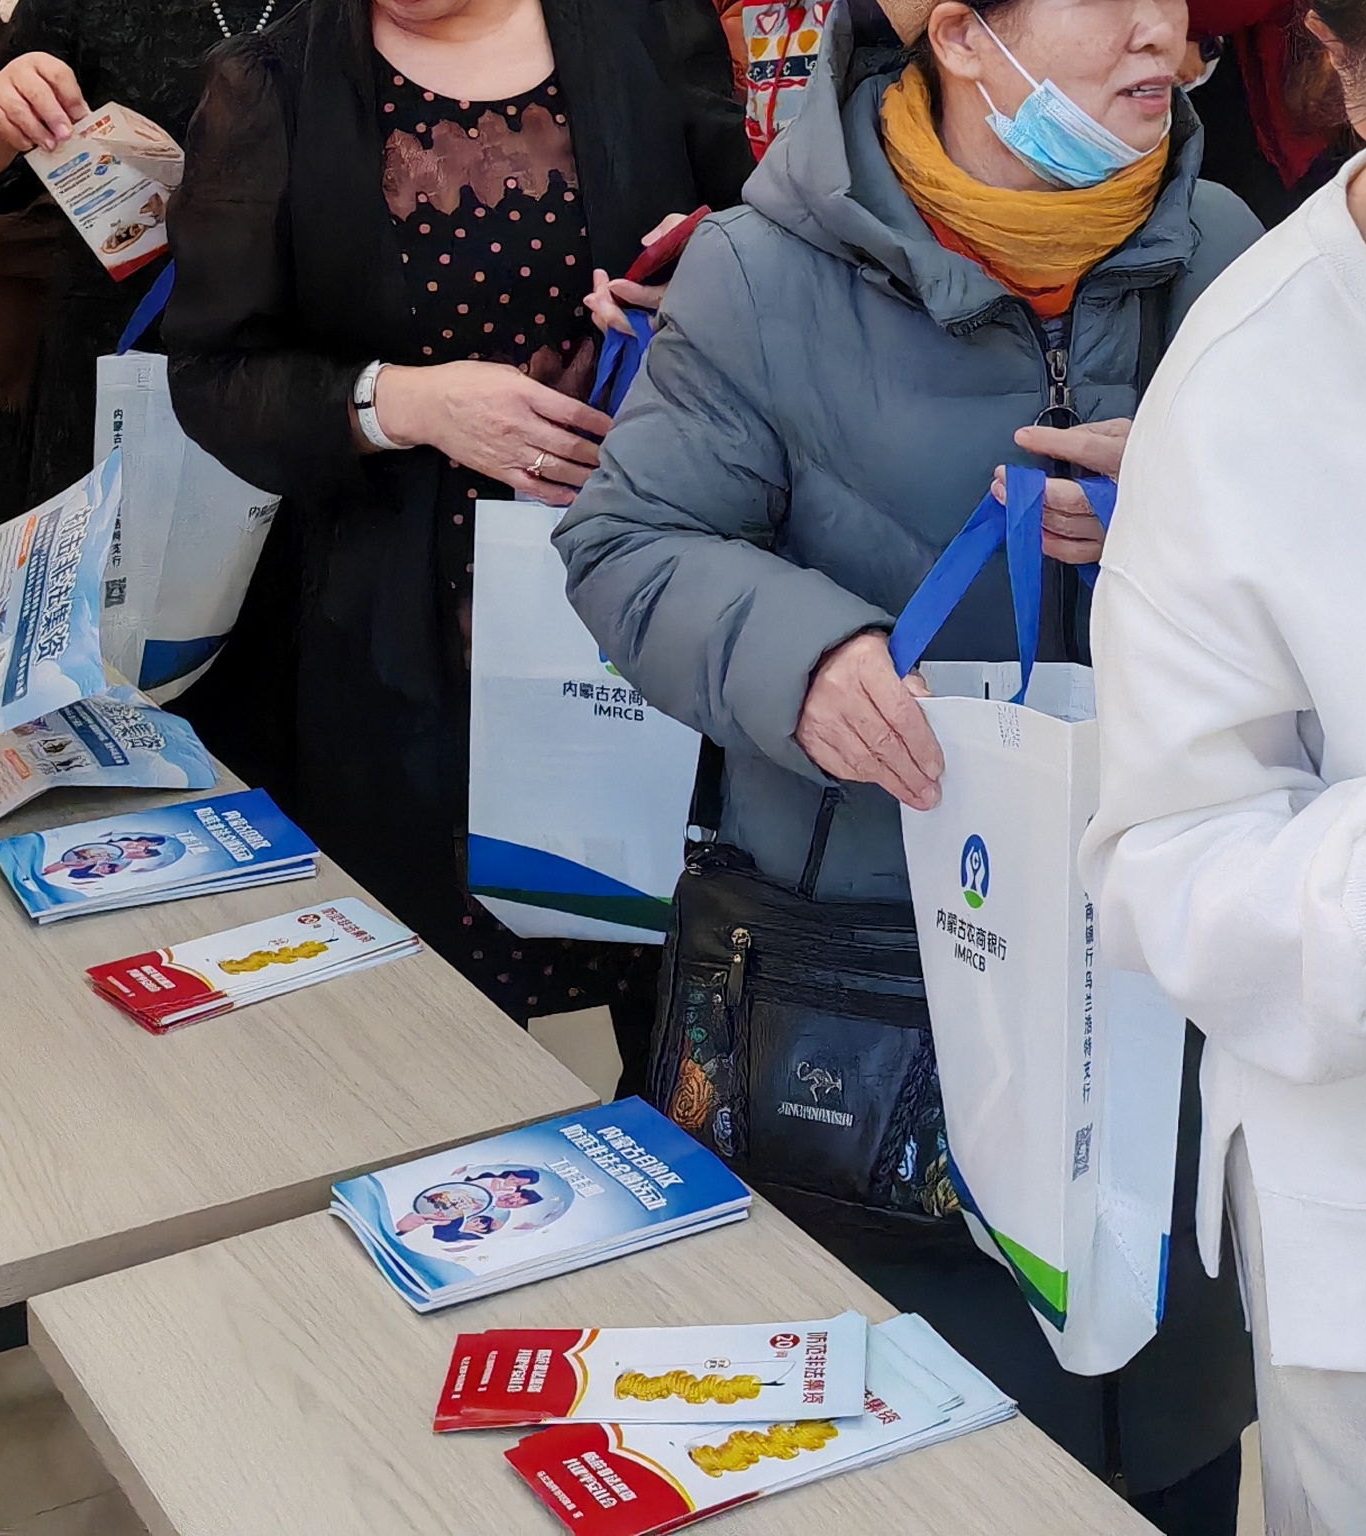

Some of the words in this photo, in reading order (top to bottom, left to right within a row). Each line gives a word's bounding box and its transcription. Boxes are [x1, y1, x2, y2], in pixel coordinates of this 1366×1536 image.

[593, 702, 645, 722] IMRCB
[936, 907, 1008, 961] 内蒙古农商银行
[954, 942, 986, 973] IMRCB
[864, 1384, 902, 1426] 集资
